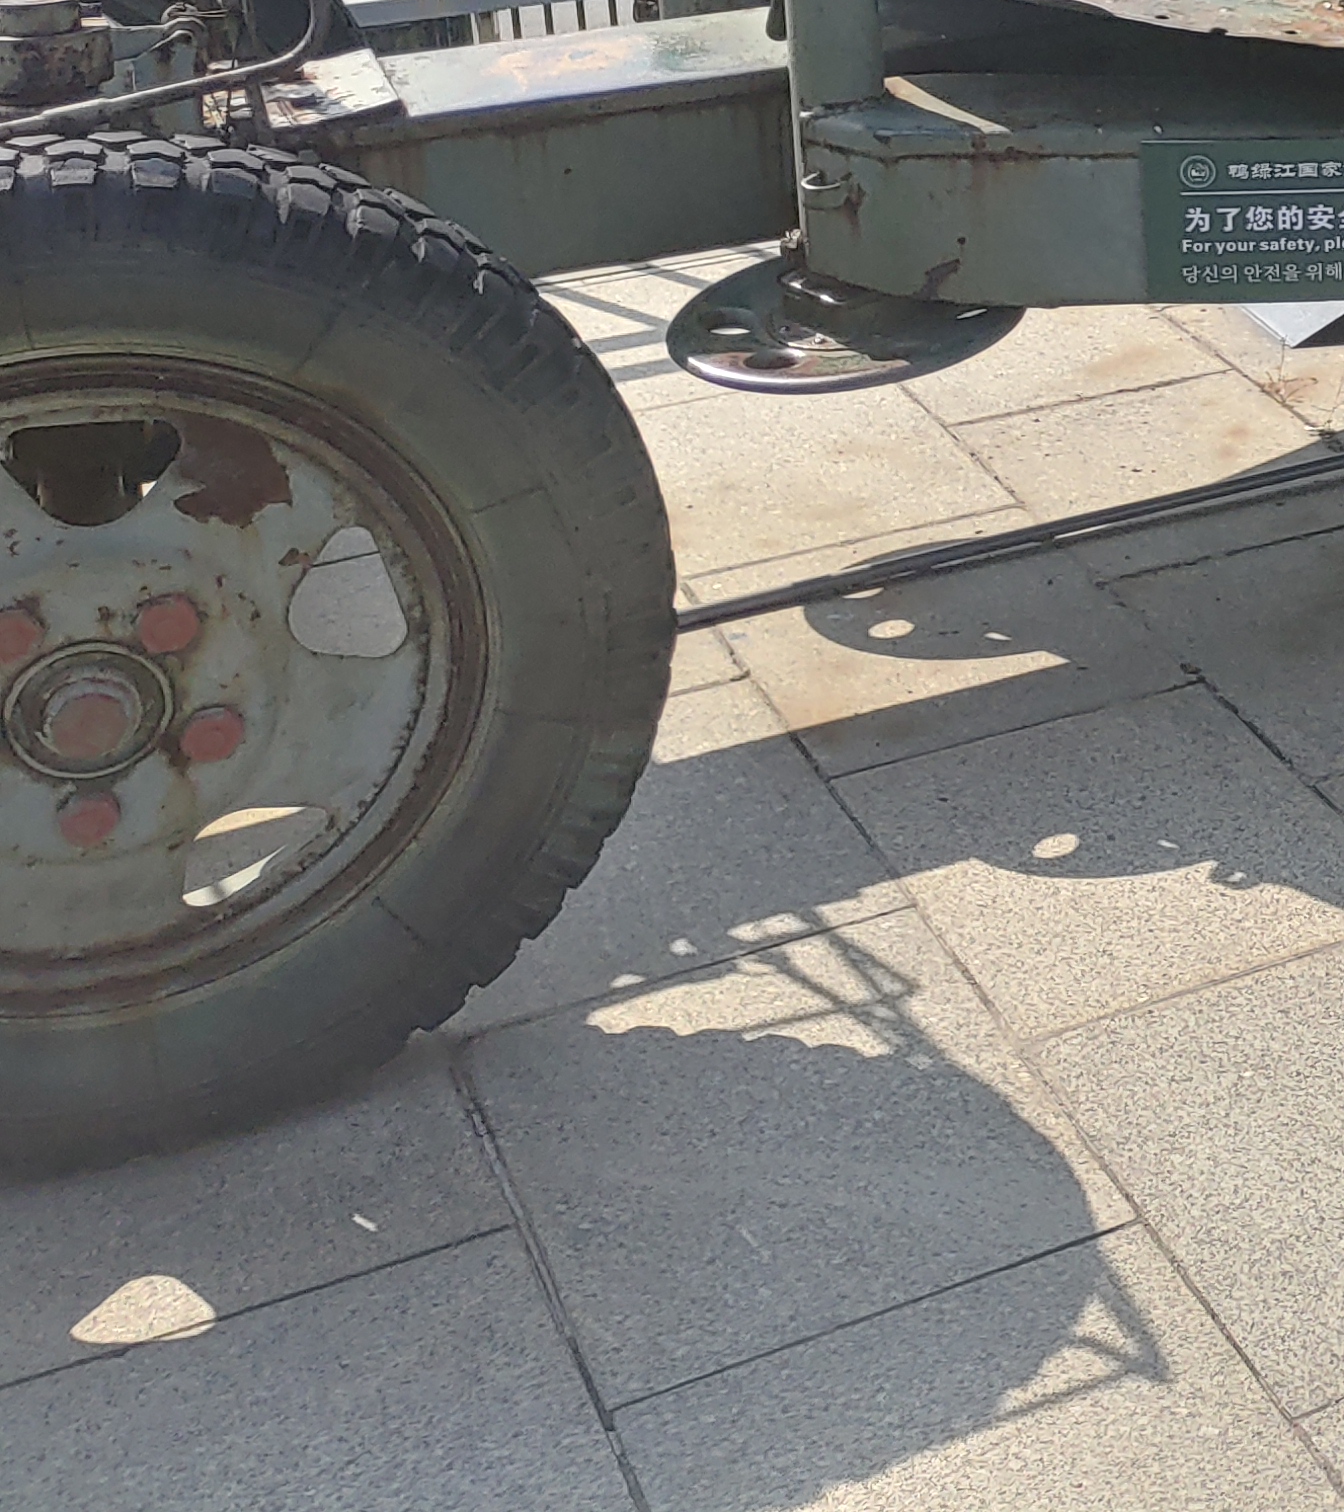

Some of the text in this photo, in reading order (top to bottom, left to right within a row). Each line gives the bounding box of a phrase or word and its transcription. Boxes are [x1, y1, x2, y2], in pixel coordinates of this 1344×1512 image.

[1182, 239, 1212, 253] For
[1214, 242, 1256, 255] your
[1259, 237, 1321, 255] safety,
[1182, 264, 1238, 284] 당신의
[1244, 263, 1302, 283] 안전을
